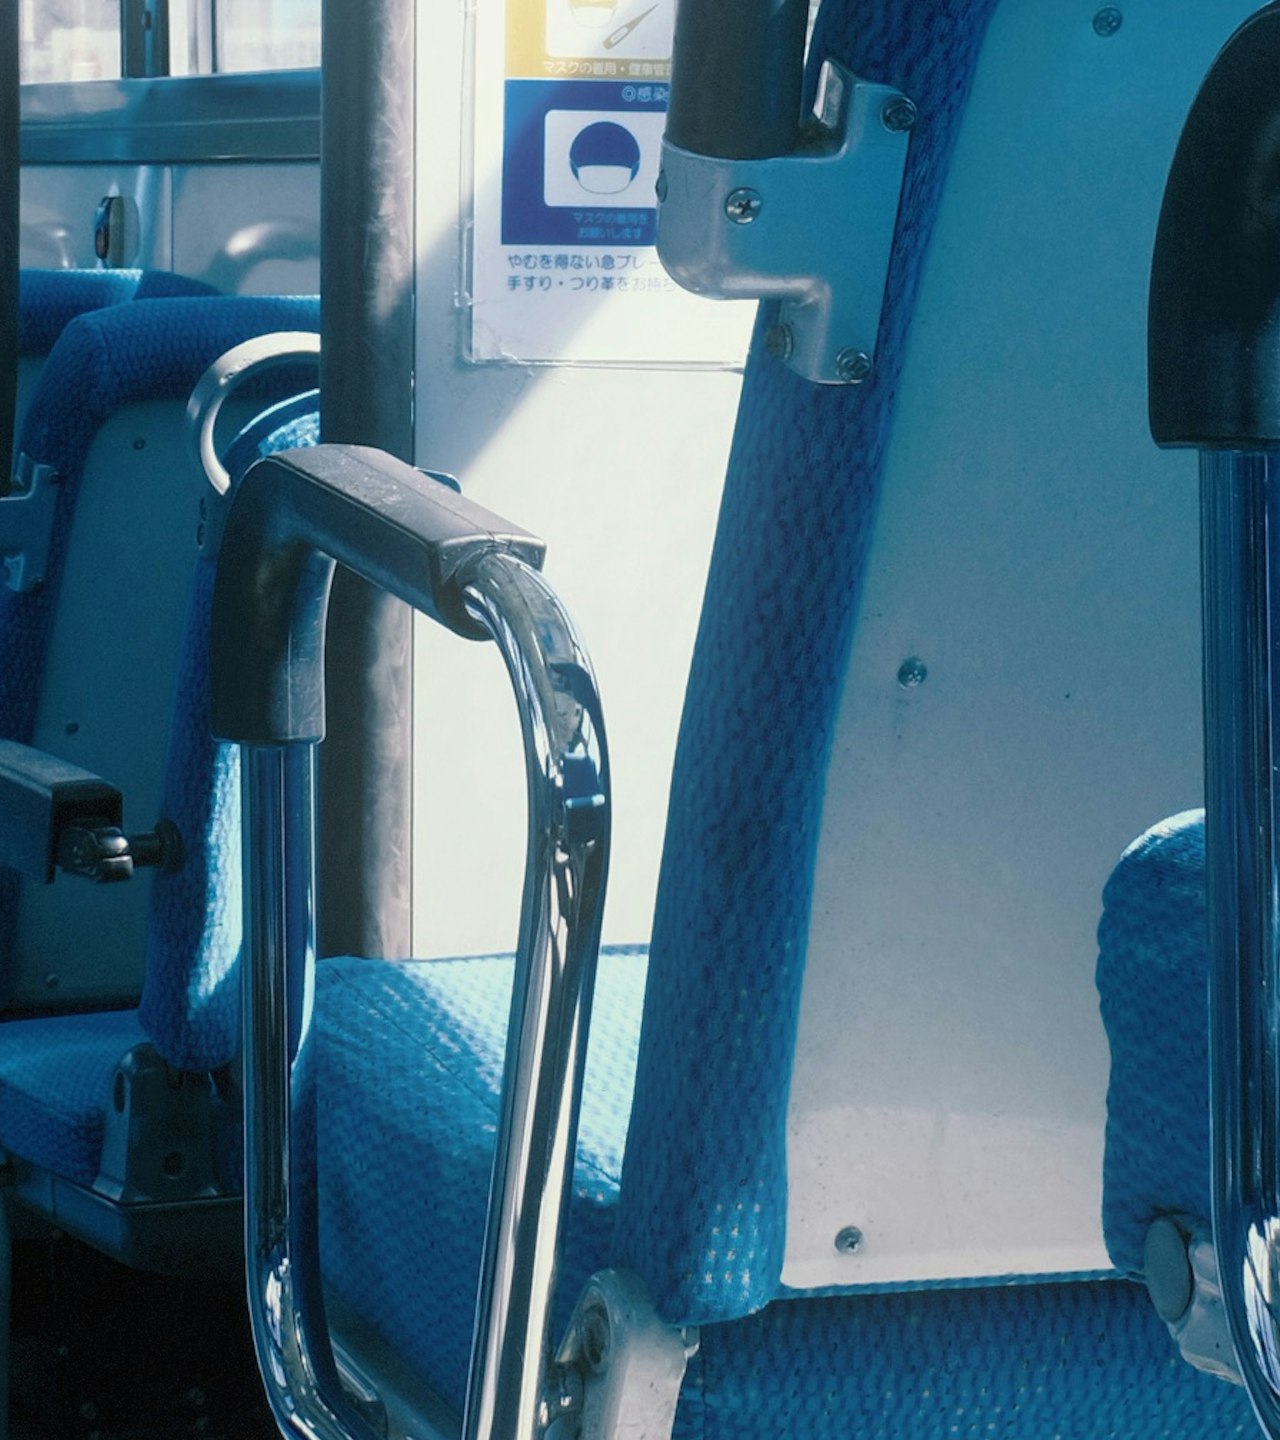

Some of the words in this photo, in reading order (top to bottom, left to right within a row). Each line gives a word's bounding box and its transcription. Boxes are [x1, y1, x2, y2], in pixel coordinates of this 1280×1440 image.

[577, 227, 642, 241] お願いします
